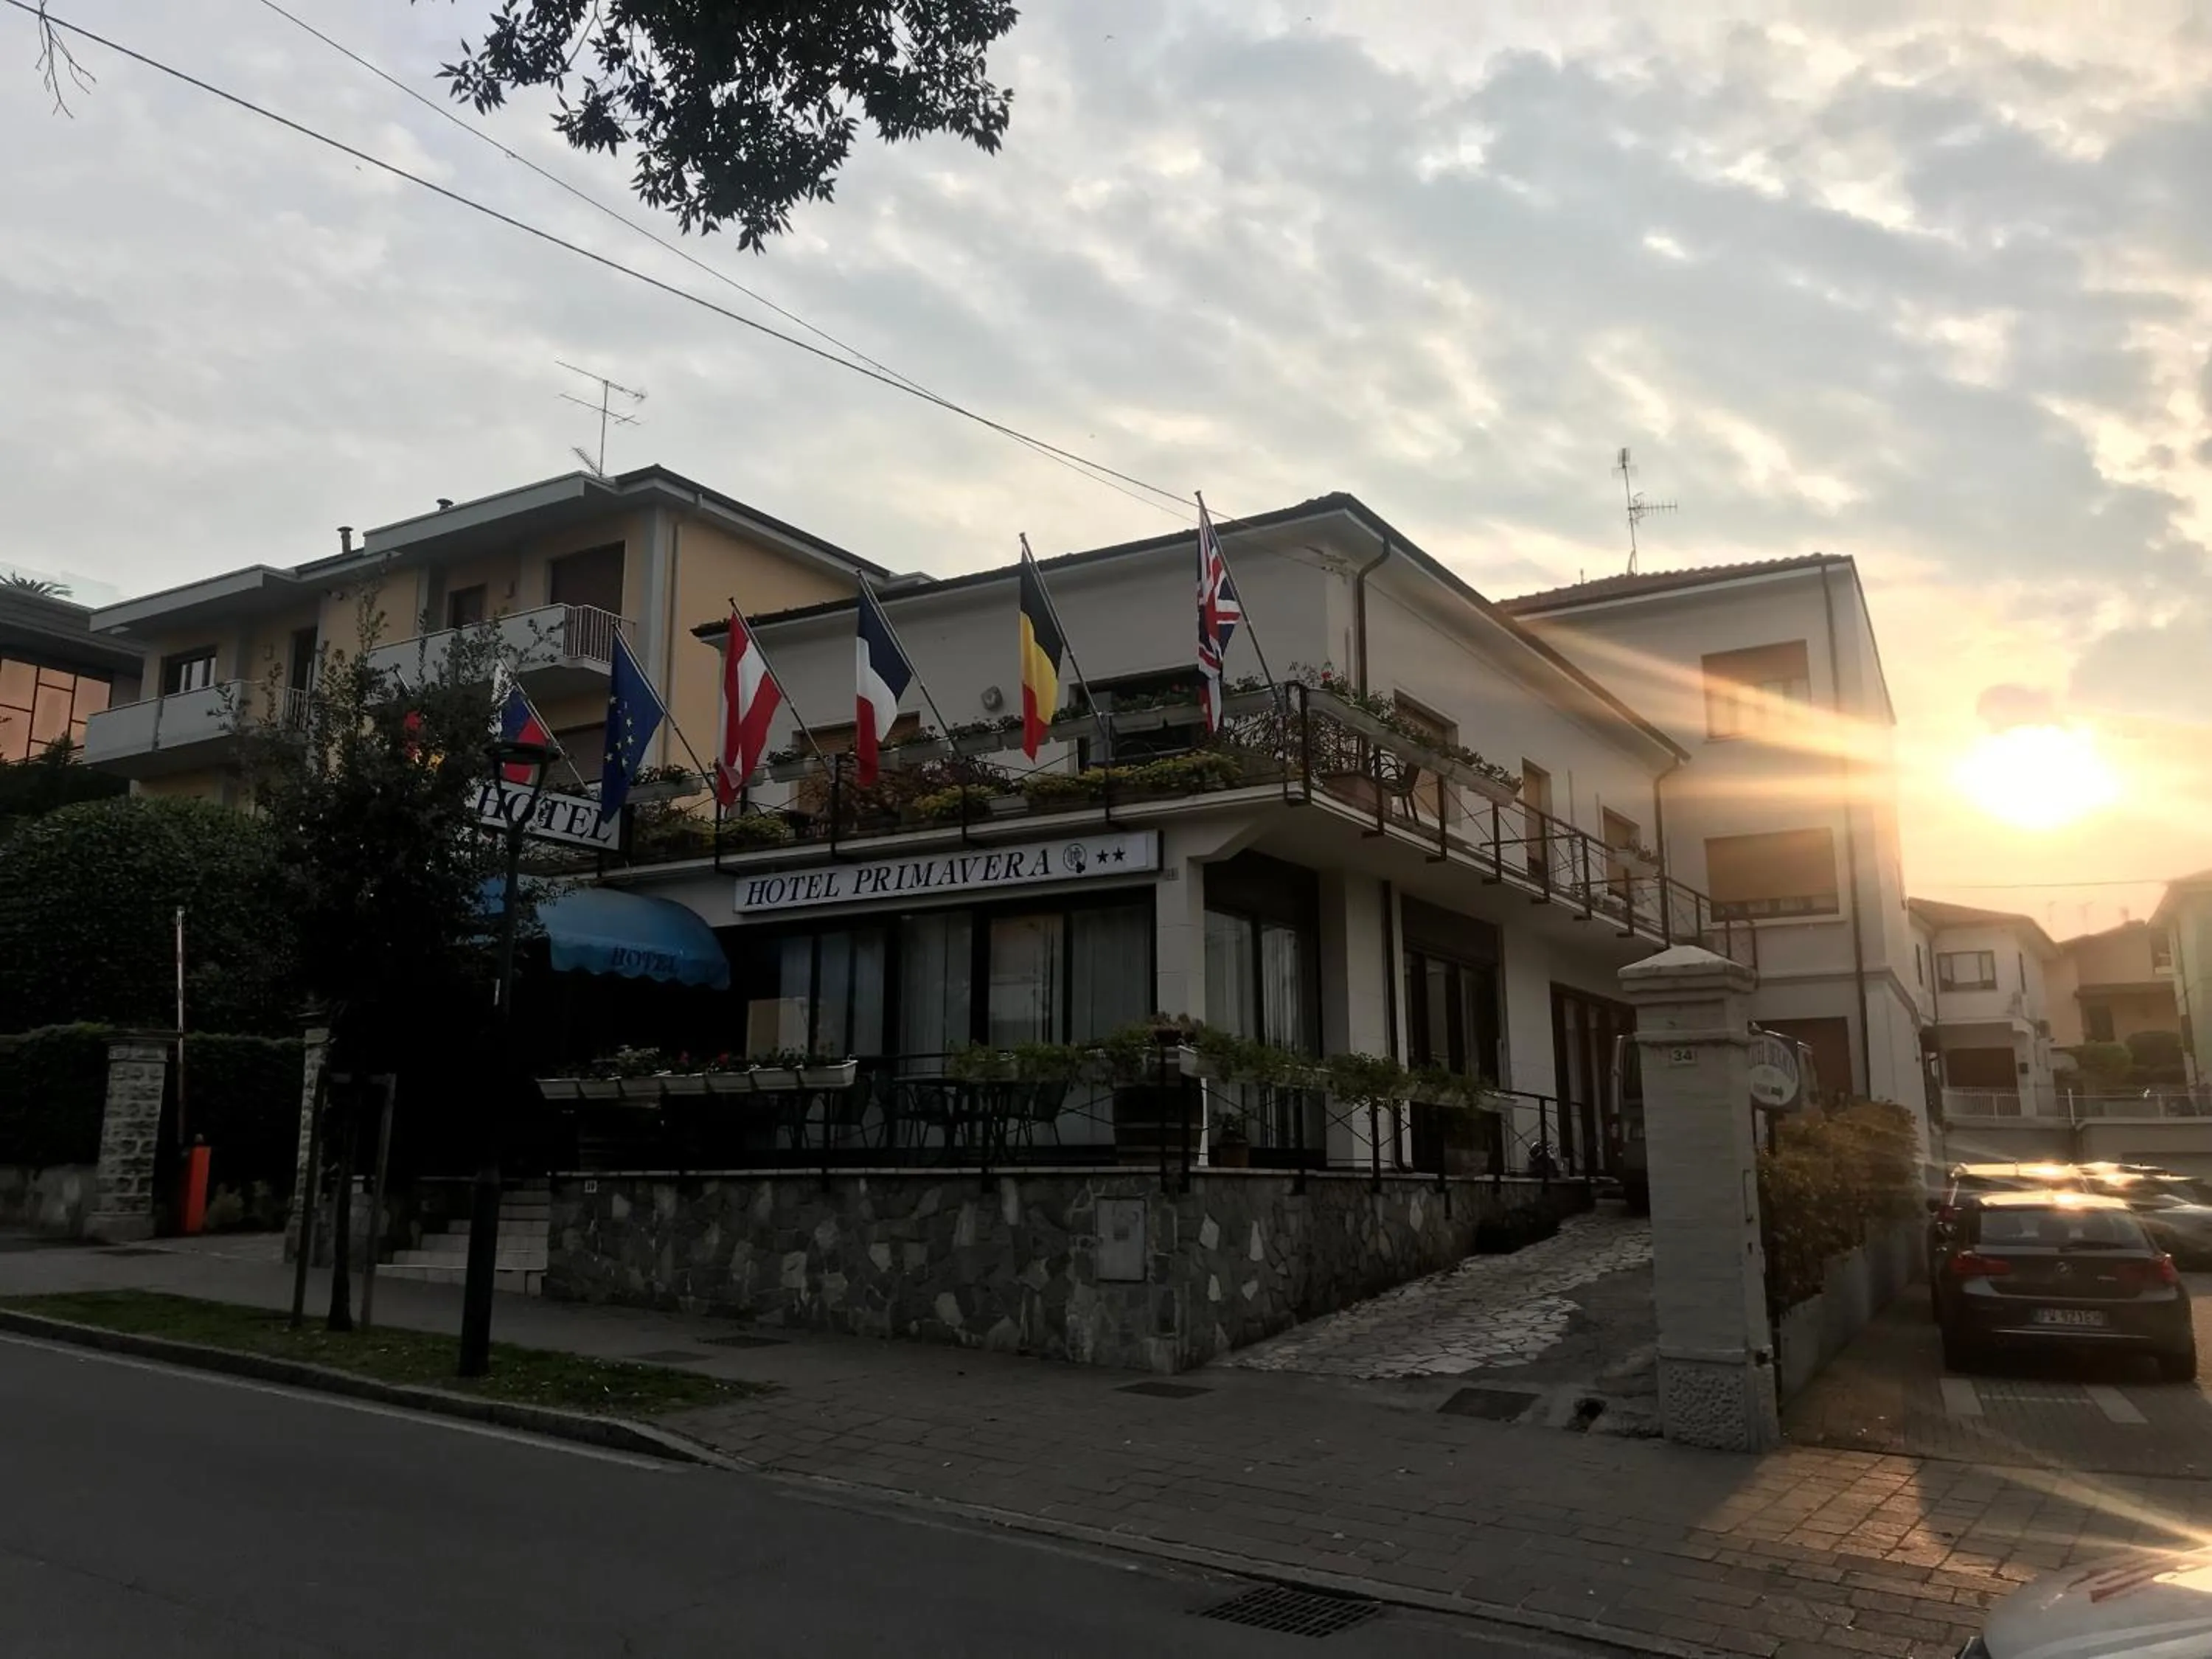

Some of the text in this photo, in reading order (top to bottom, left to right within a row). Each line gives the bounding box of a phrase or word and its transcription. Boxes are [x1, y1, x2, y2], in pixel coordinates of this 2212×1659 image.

[478, 785, 613, 844] HOTEL
[745, 849, 1052, 906] HOTEL PRIMAVERA
[611, 945, 681, 974] HOTEL
[1672, 1049, 1693, 1062] 34
